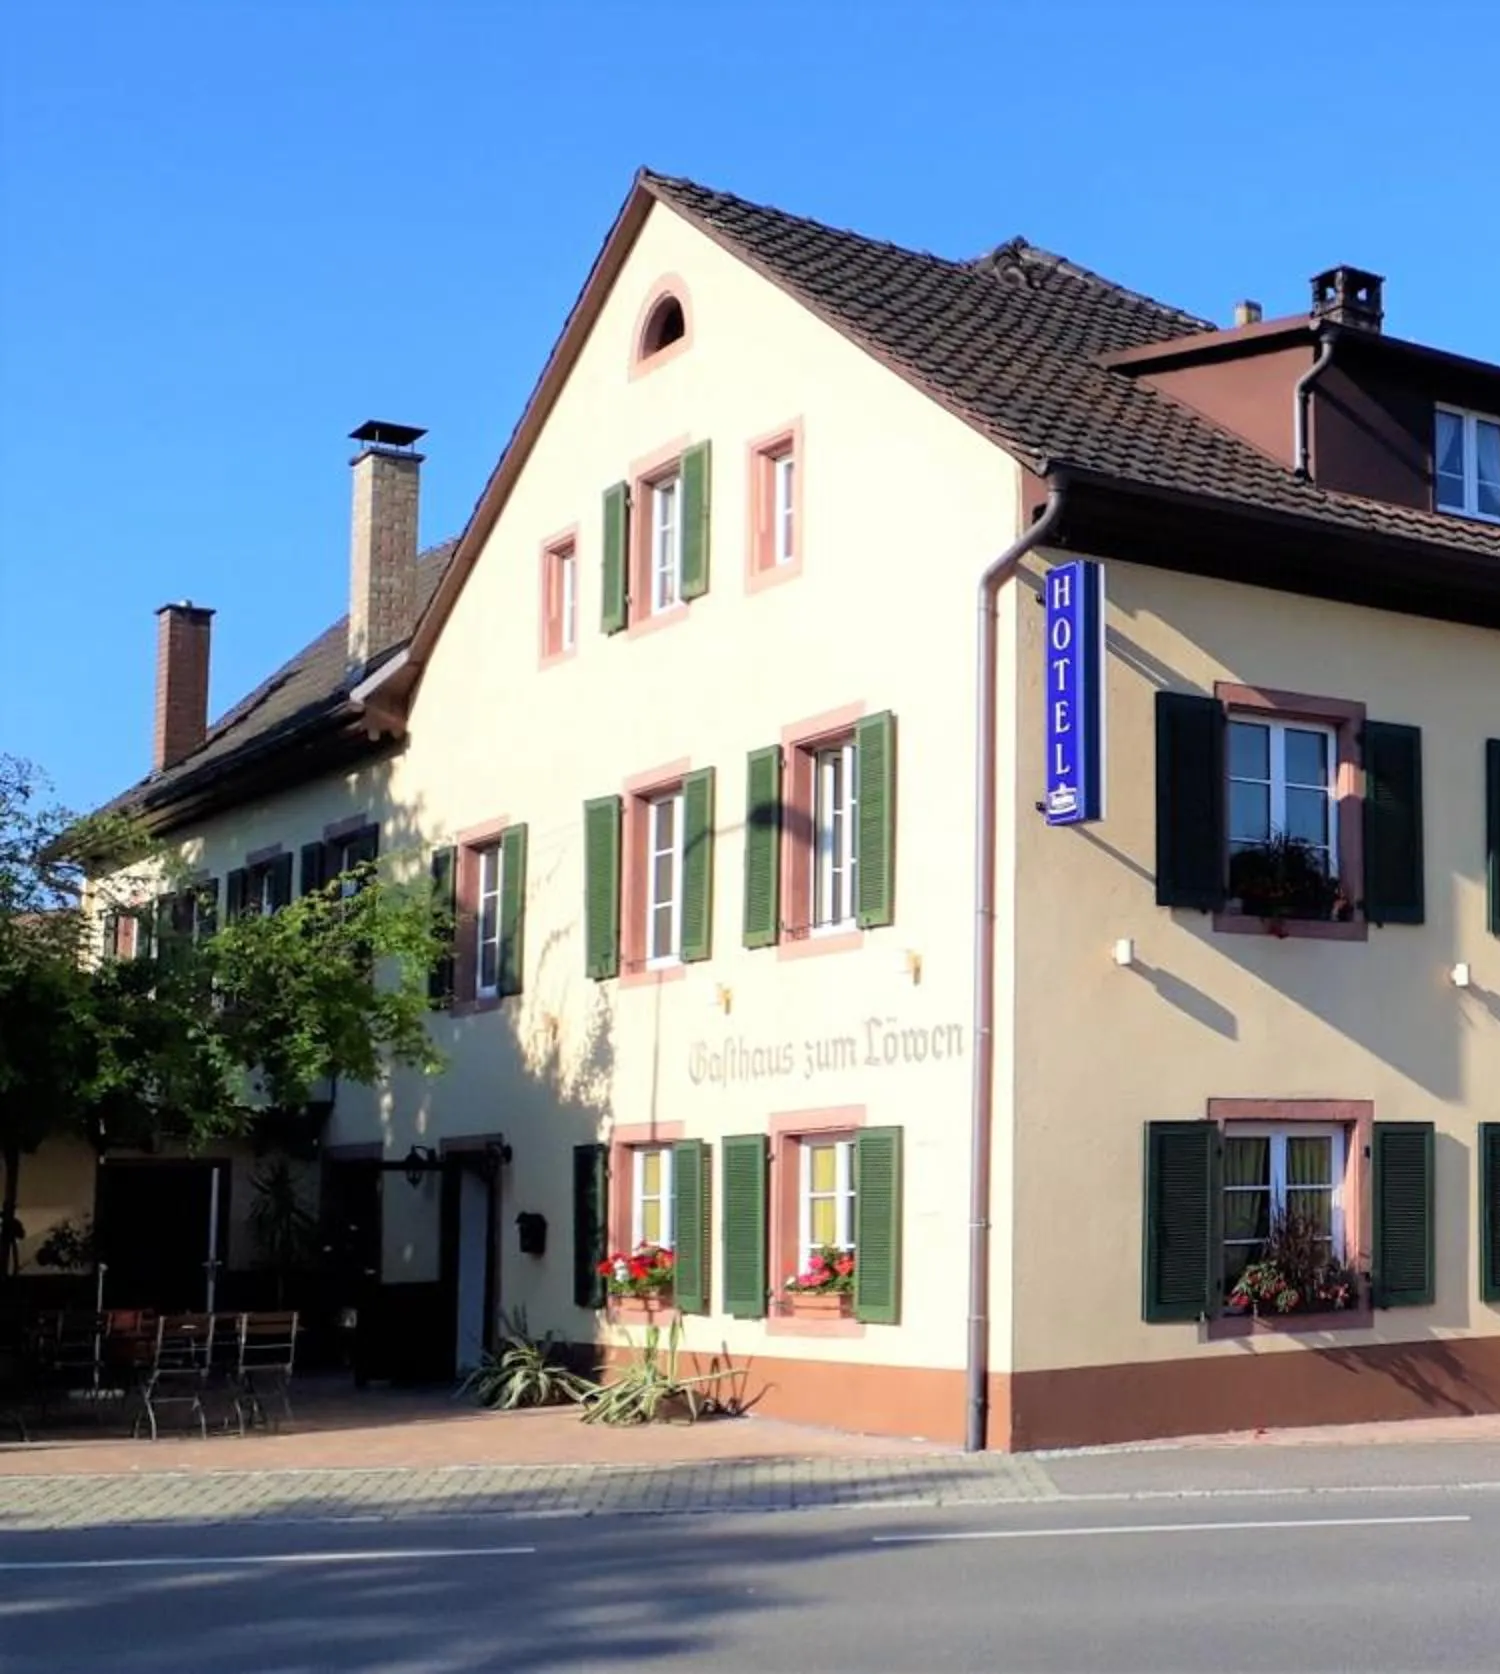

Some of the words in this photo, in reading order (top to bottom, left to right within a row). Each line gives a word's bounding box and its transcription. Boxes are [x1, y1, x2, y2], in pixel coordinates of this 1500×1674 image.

[1052, 574, 1071, 775] HOTEL
[803, 1034, 857, 1080] zum
[863, 1016, 964, 1067] Löwen
